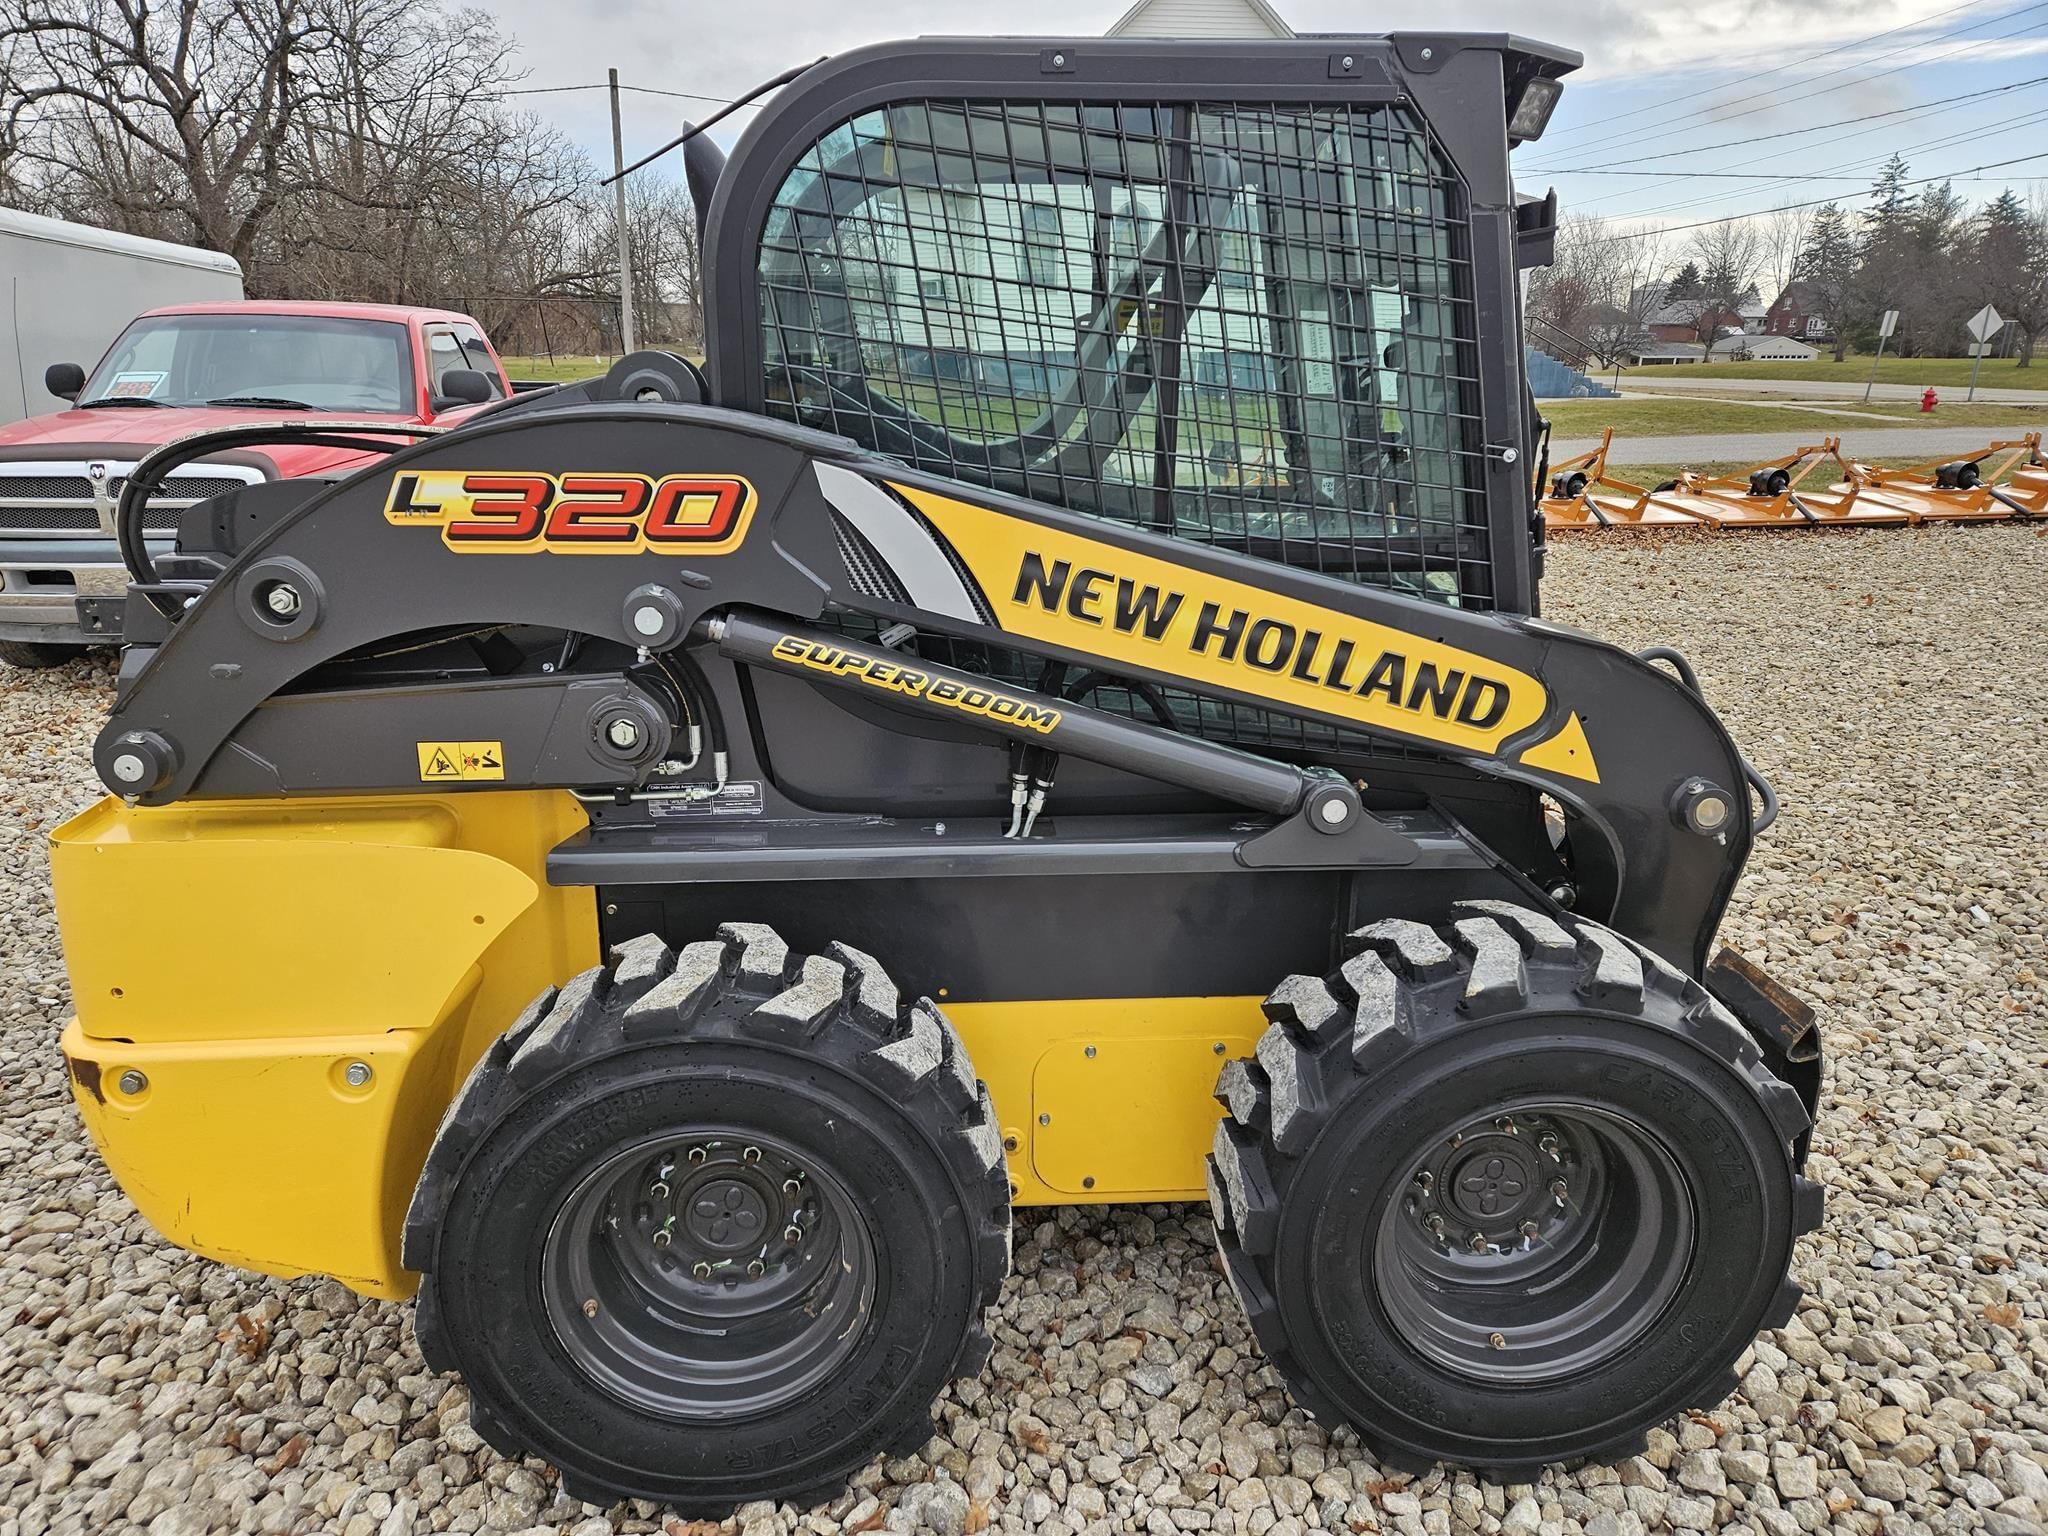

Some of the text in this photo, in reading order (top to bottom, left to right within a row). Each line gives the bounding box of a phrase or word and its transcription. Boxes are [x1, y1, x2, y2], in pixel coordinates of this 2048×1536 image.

[386, 472, 751, 546] L320
[773, 636, 1062, 734] SUPER BOOM
[1012, 548, 1512, 731] NEW HOLLAND
[725, 1344, 913, 1469] CARLSTAR
